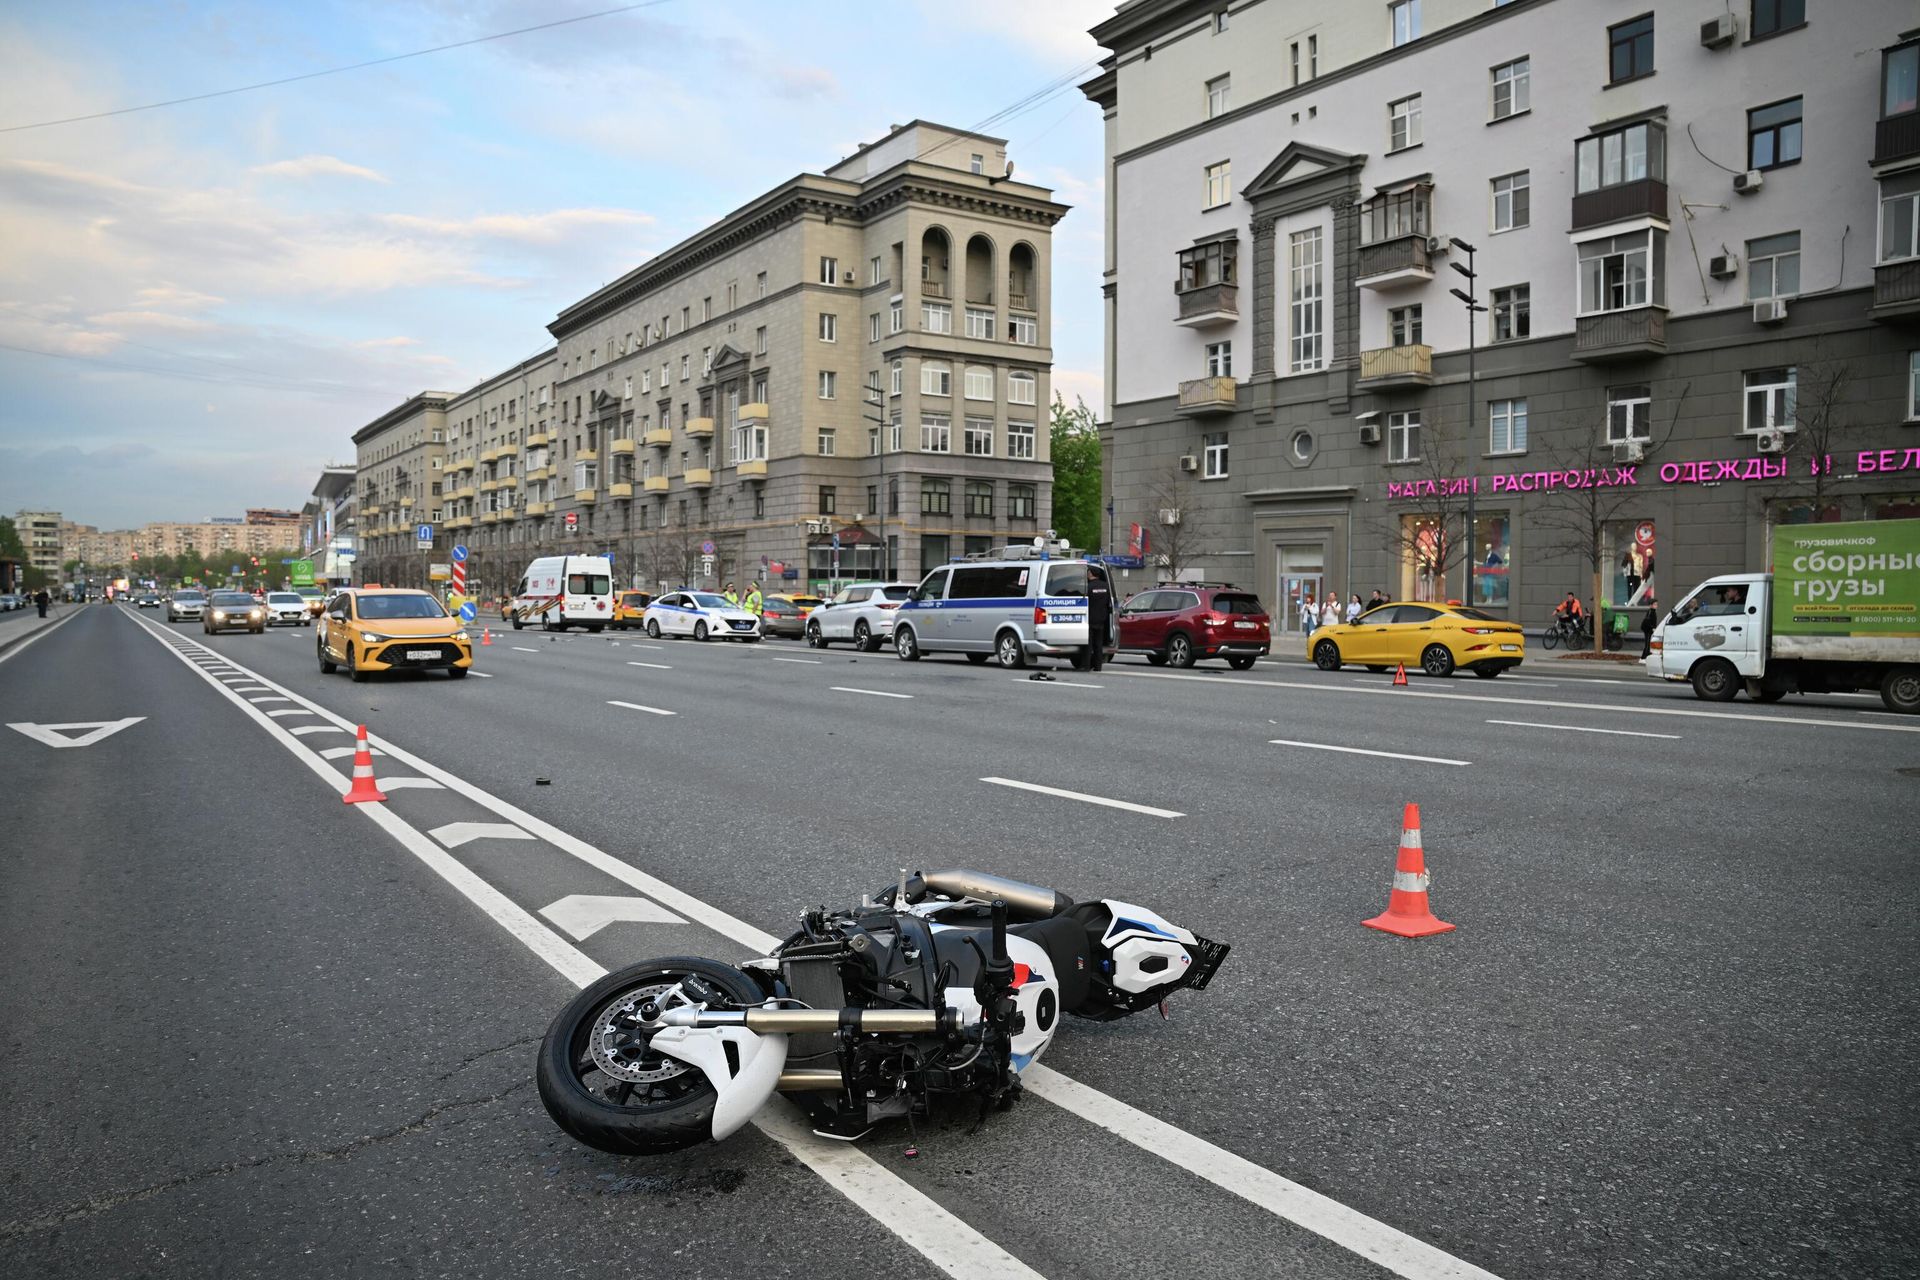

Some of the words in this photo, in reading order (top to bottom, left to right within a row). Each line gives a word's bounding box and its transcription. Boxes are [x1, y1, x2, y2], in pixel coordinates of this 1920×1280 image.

[1388, 477, 1477, 499] МАГАЗИН
[1493, 466, 1637, 493] РАСПРОДАЖ
[1660, 456, 1786, 482] ОДЕЖДЫ
[1794, 537, 1876, 549] грузовичкоф
[1793, 579, 1885, 602] грузы
[688, 978, 708, 995] brembo
